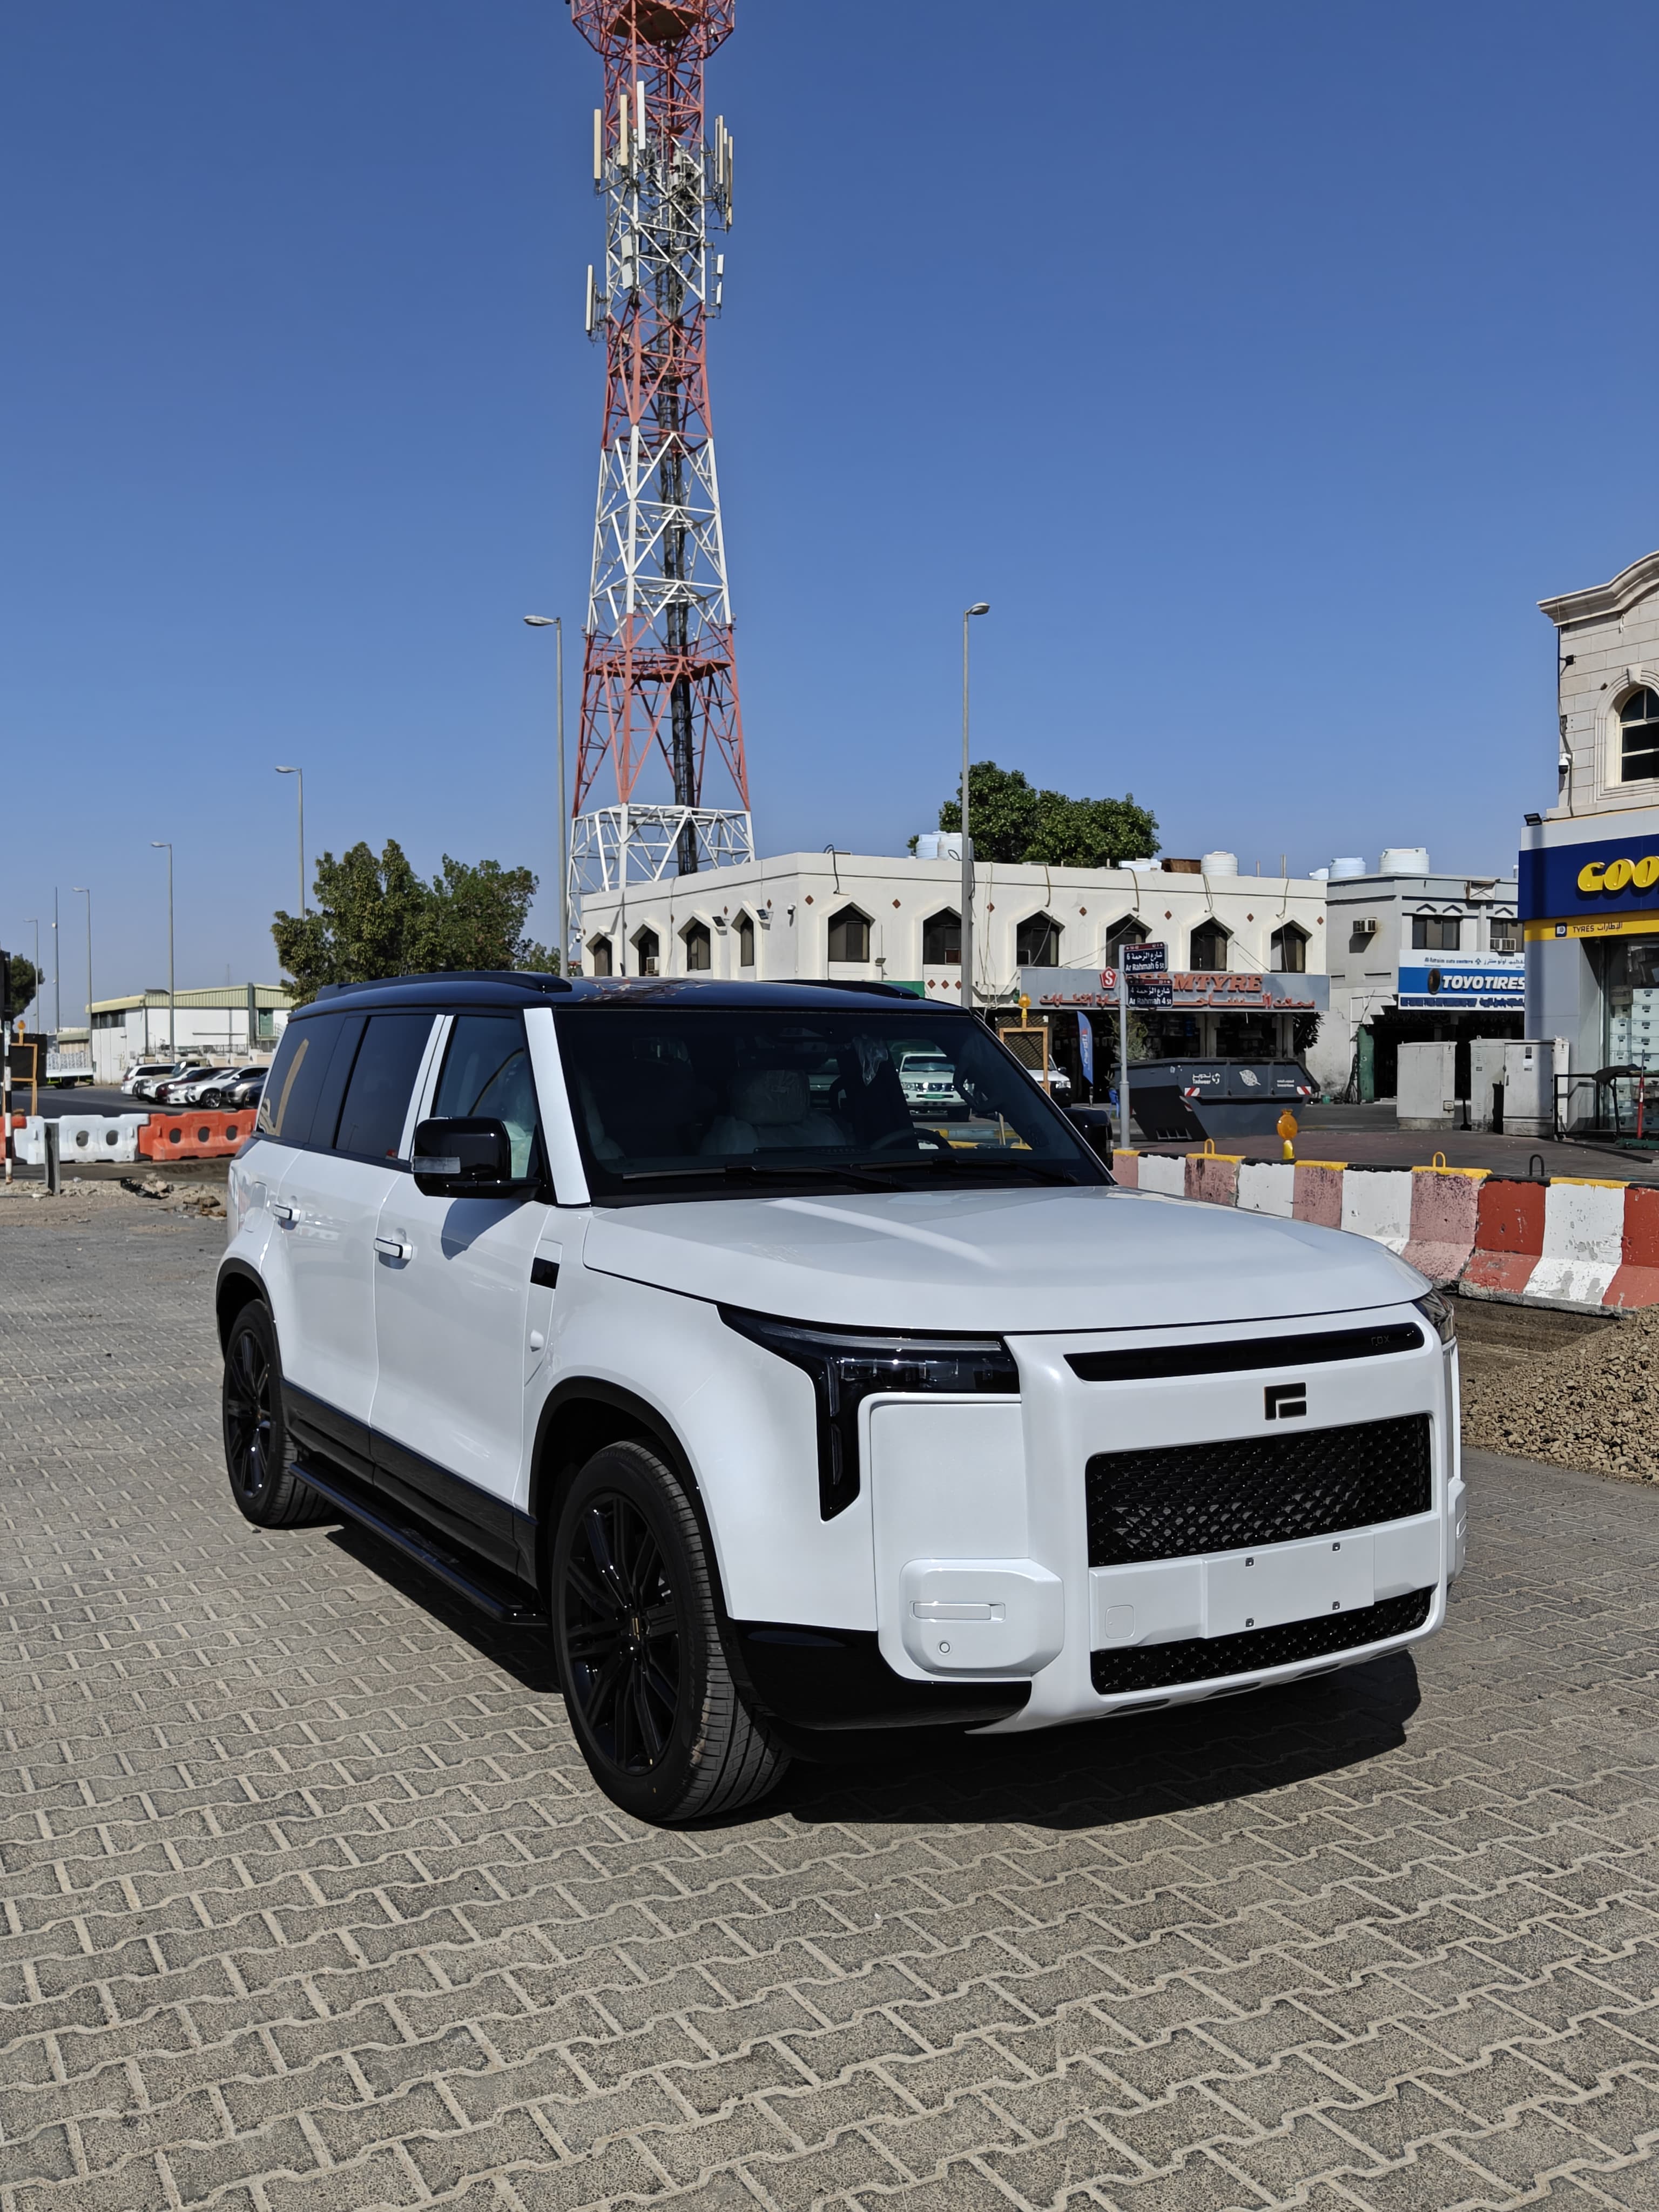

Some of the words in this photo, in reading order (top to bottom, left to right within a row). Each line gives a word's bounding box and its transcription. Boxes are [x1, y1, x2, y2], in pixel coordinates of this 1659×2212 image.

[1577, 856, 1659, 892] GOO
[1573, 925, 1594, 933] TYRES
[1150, 951, 1163, 961] شارع
[1132, 962, 1155, 970] Rahmah
[1105, 970, 1113, 985] S
[1157, 987, 1170, 997] شارع
